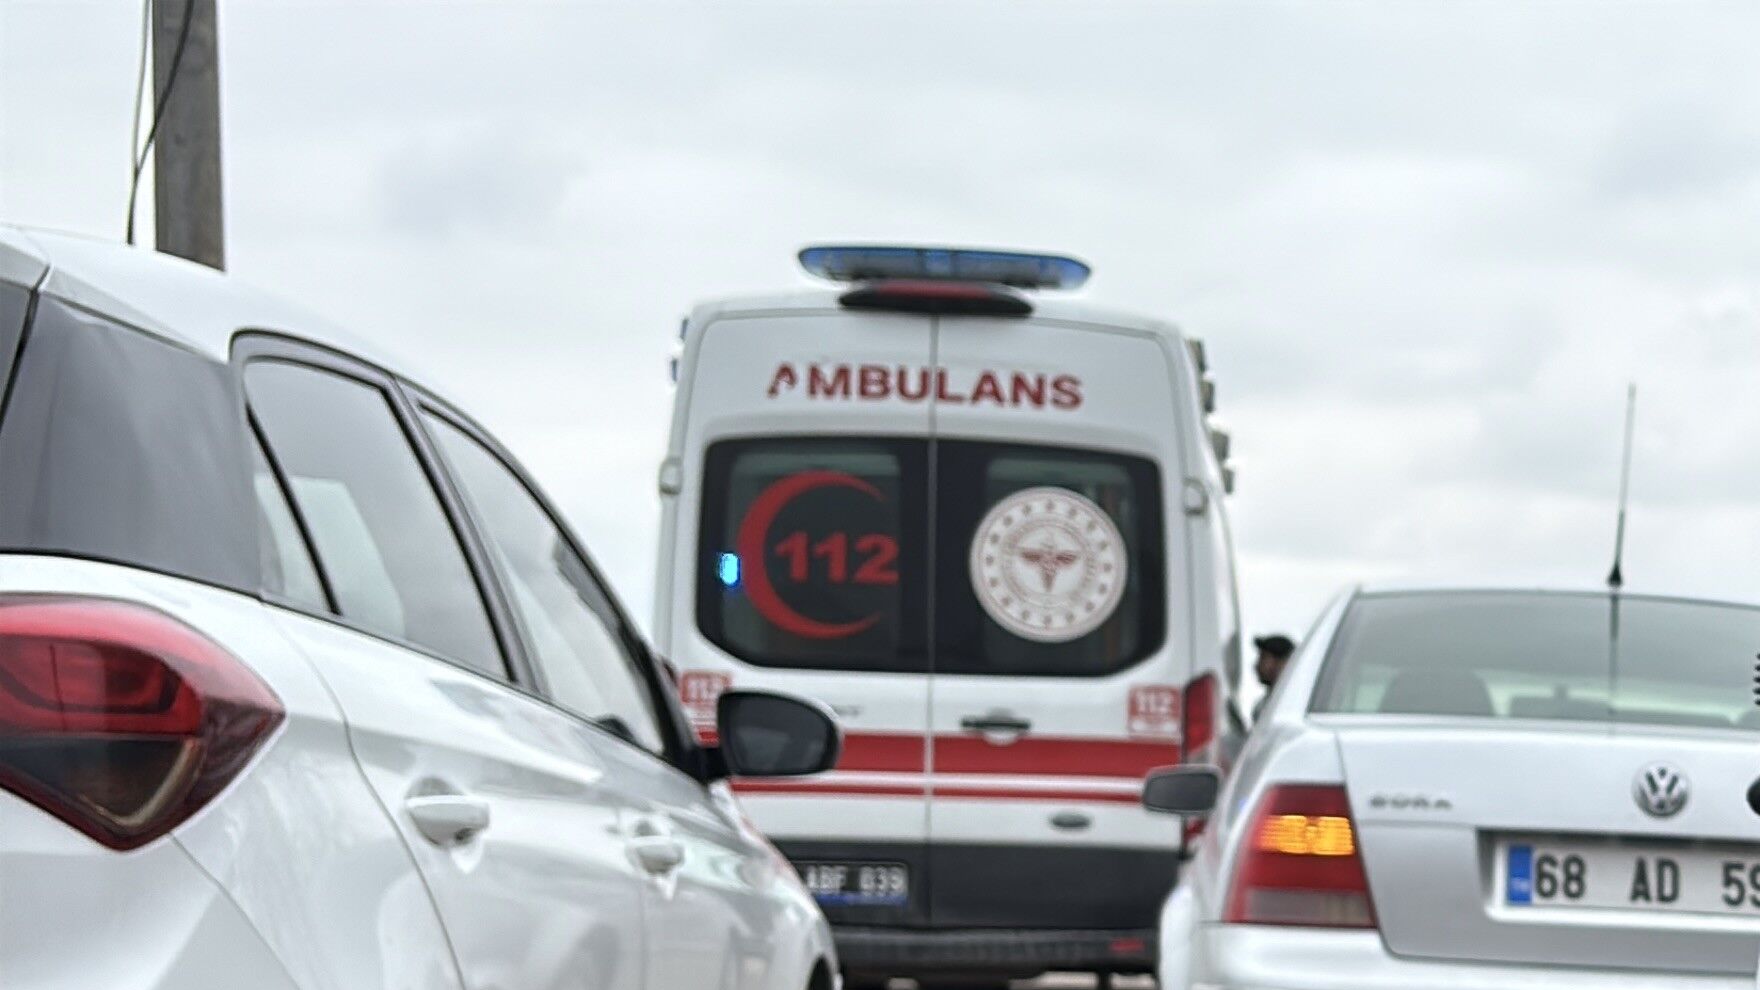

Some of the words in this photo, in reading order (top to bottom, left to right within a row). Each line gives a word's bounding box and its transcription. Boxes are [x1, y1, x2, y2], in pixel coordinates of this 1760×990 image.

[767, 363, 1084, 409] AMBULANS
[776, 533, 898, 583] 112
[1535, 855, 1585, 899] 68
[1629, 858, 1680, 903] AD
